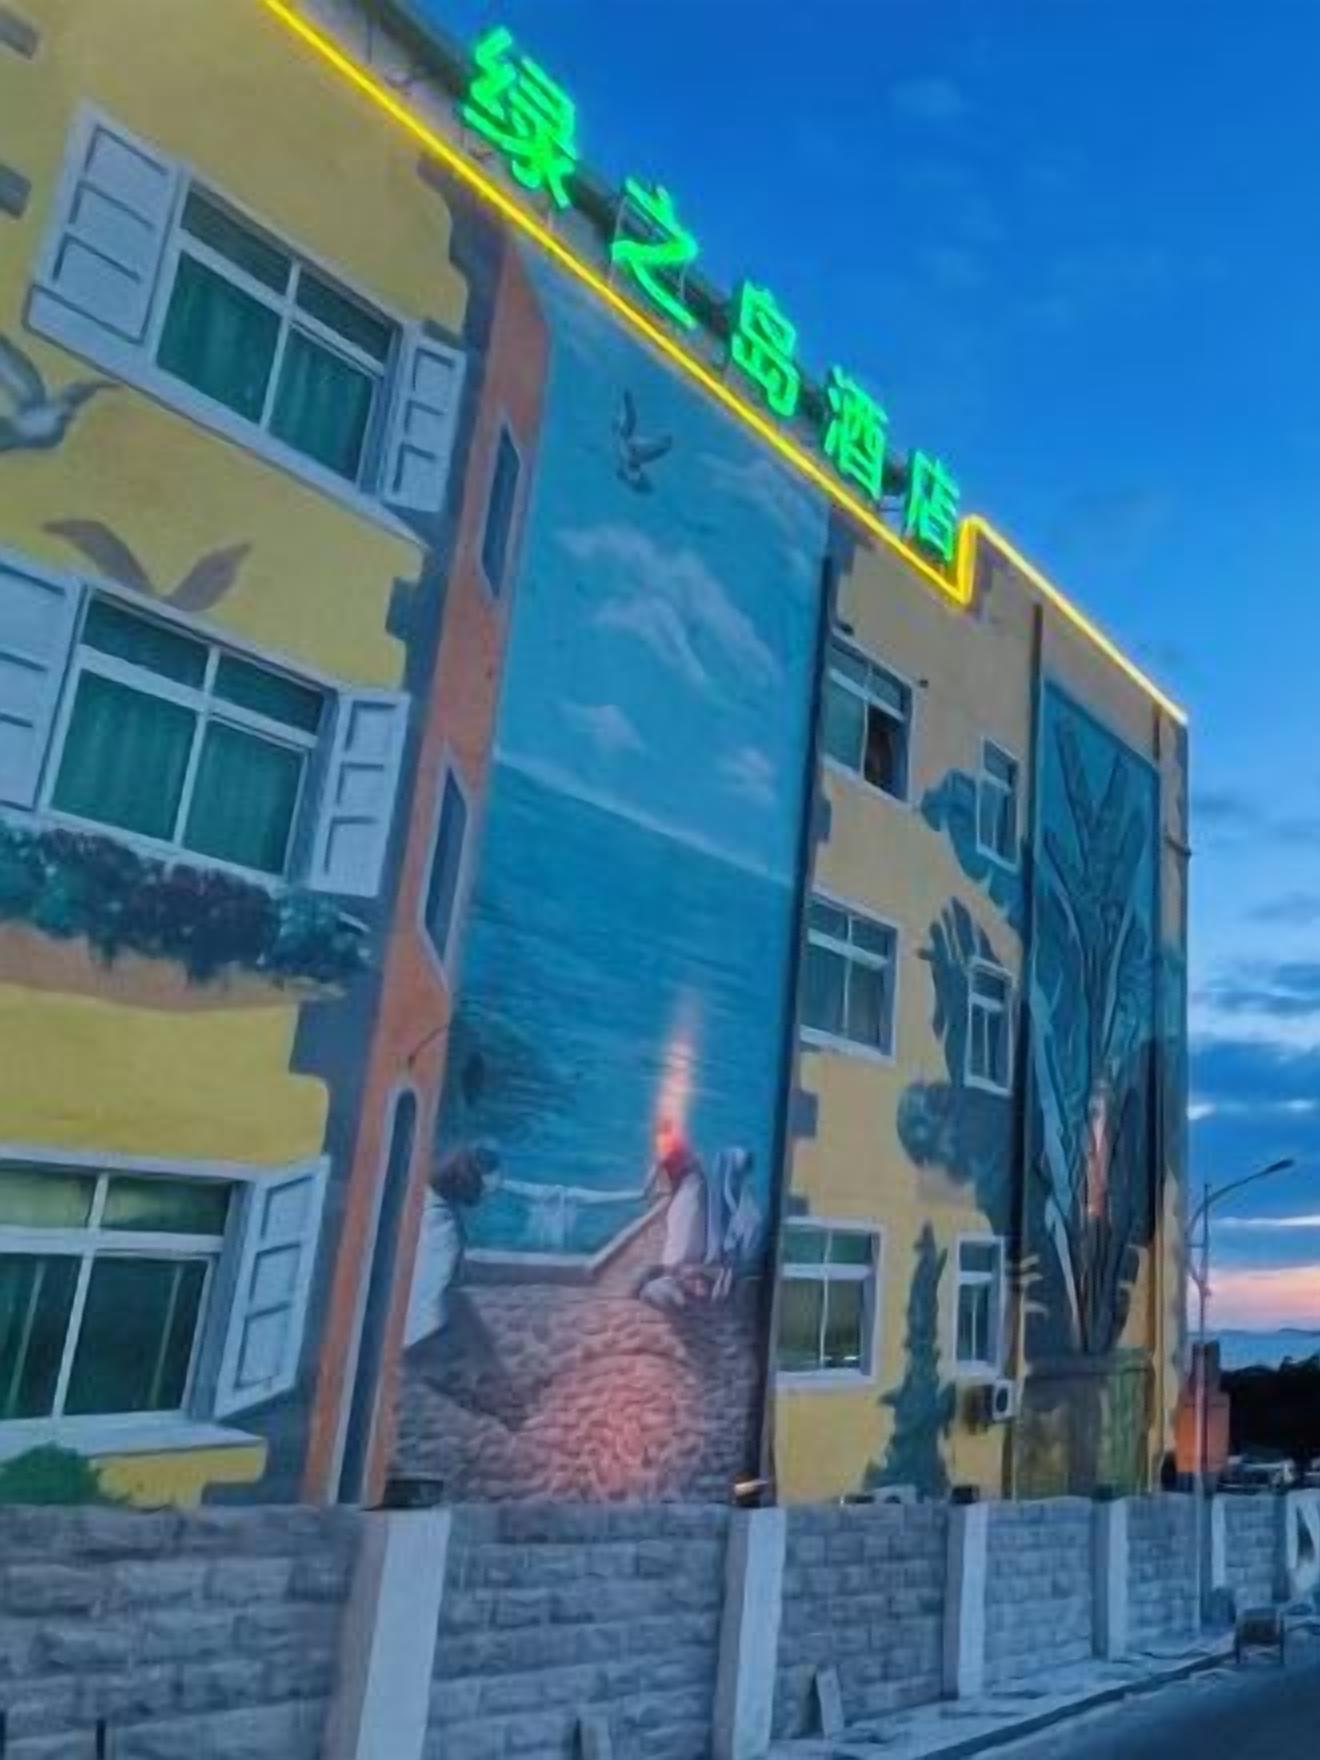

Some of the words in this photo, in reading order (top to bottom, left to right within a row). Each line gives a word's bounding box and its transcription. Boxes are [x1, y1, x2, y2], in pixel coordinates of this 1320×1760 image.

[462, 26, 960, 563] 绿之岛酒店
